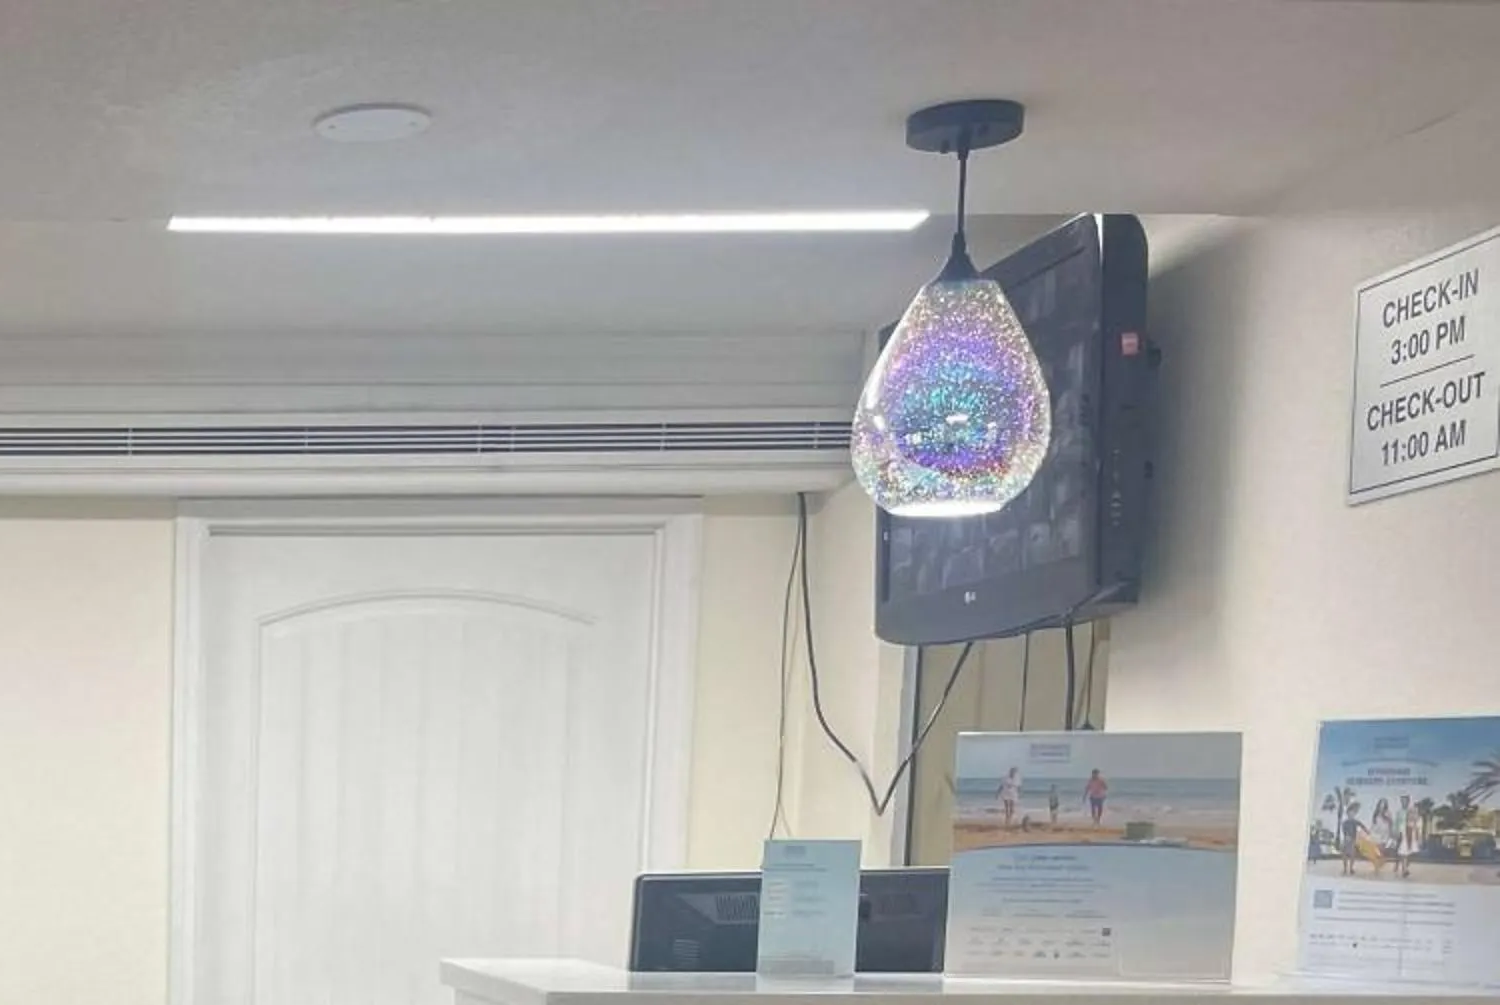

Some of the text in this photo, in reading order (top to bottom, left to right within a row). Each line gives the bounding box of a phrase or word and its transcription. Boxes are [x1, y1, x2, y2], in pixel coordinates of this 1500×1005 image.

[1383, 268, 1479, 329] CHECK-IN
[1390, 315, 1466, 365] 3:00 PM
[1367, 371, 1486, 431] CHECK-OUT
[1381, 419, 1467, 466] 11:00 AM
